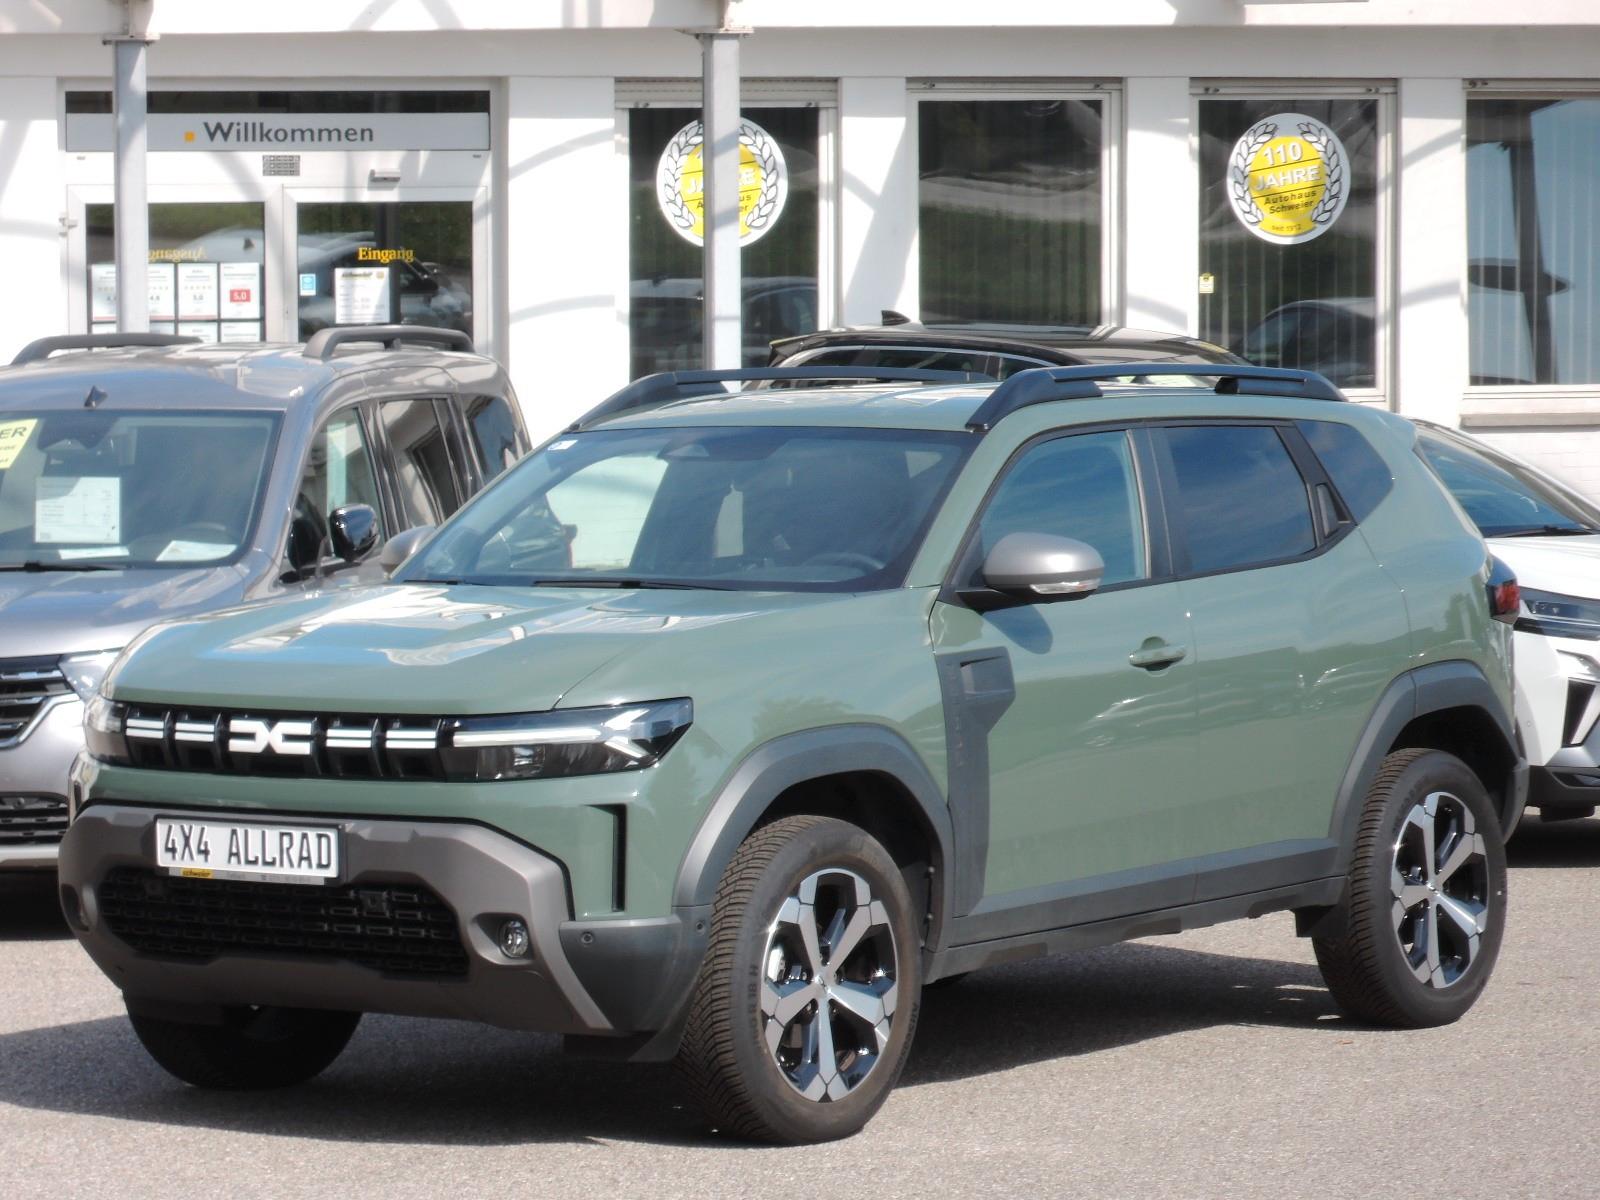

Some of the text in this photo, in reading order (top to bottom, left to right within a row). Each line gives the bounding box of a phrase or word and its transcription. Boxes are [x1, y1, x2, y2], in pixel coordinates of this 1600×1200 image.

[203, 121, 374, 142] Willkommen
[1263, 142, 1303, 166] 110
[1255, 165, 1321, 191] JAHRE
[1264, 190, 1317, 205] Autohaus
[1269, 201, 1314, 214] Schweier
[358, 247, 414, 263] Eingang
[164, 824, 332, 869] 4X4 ALLRAD
